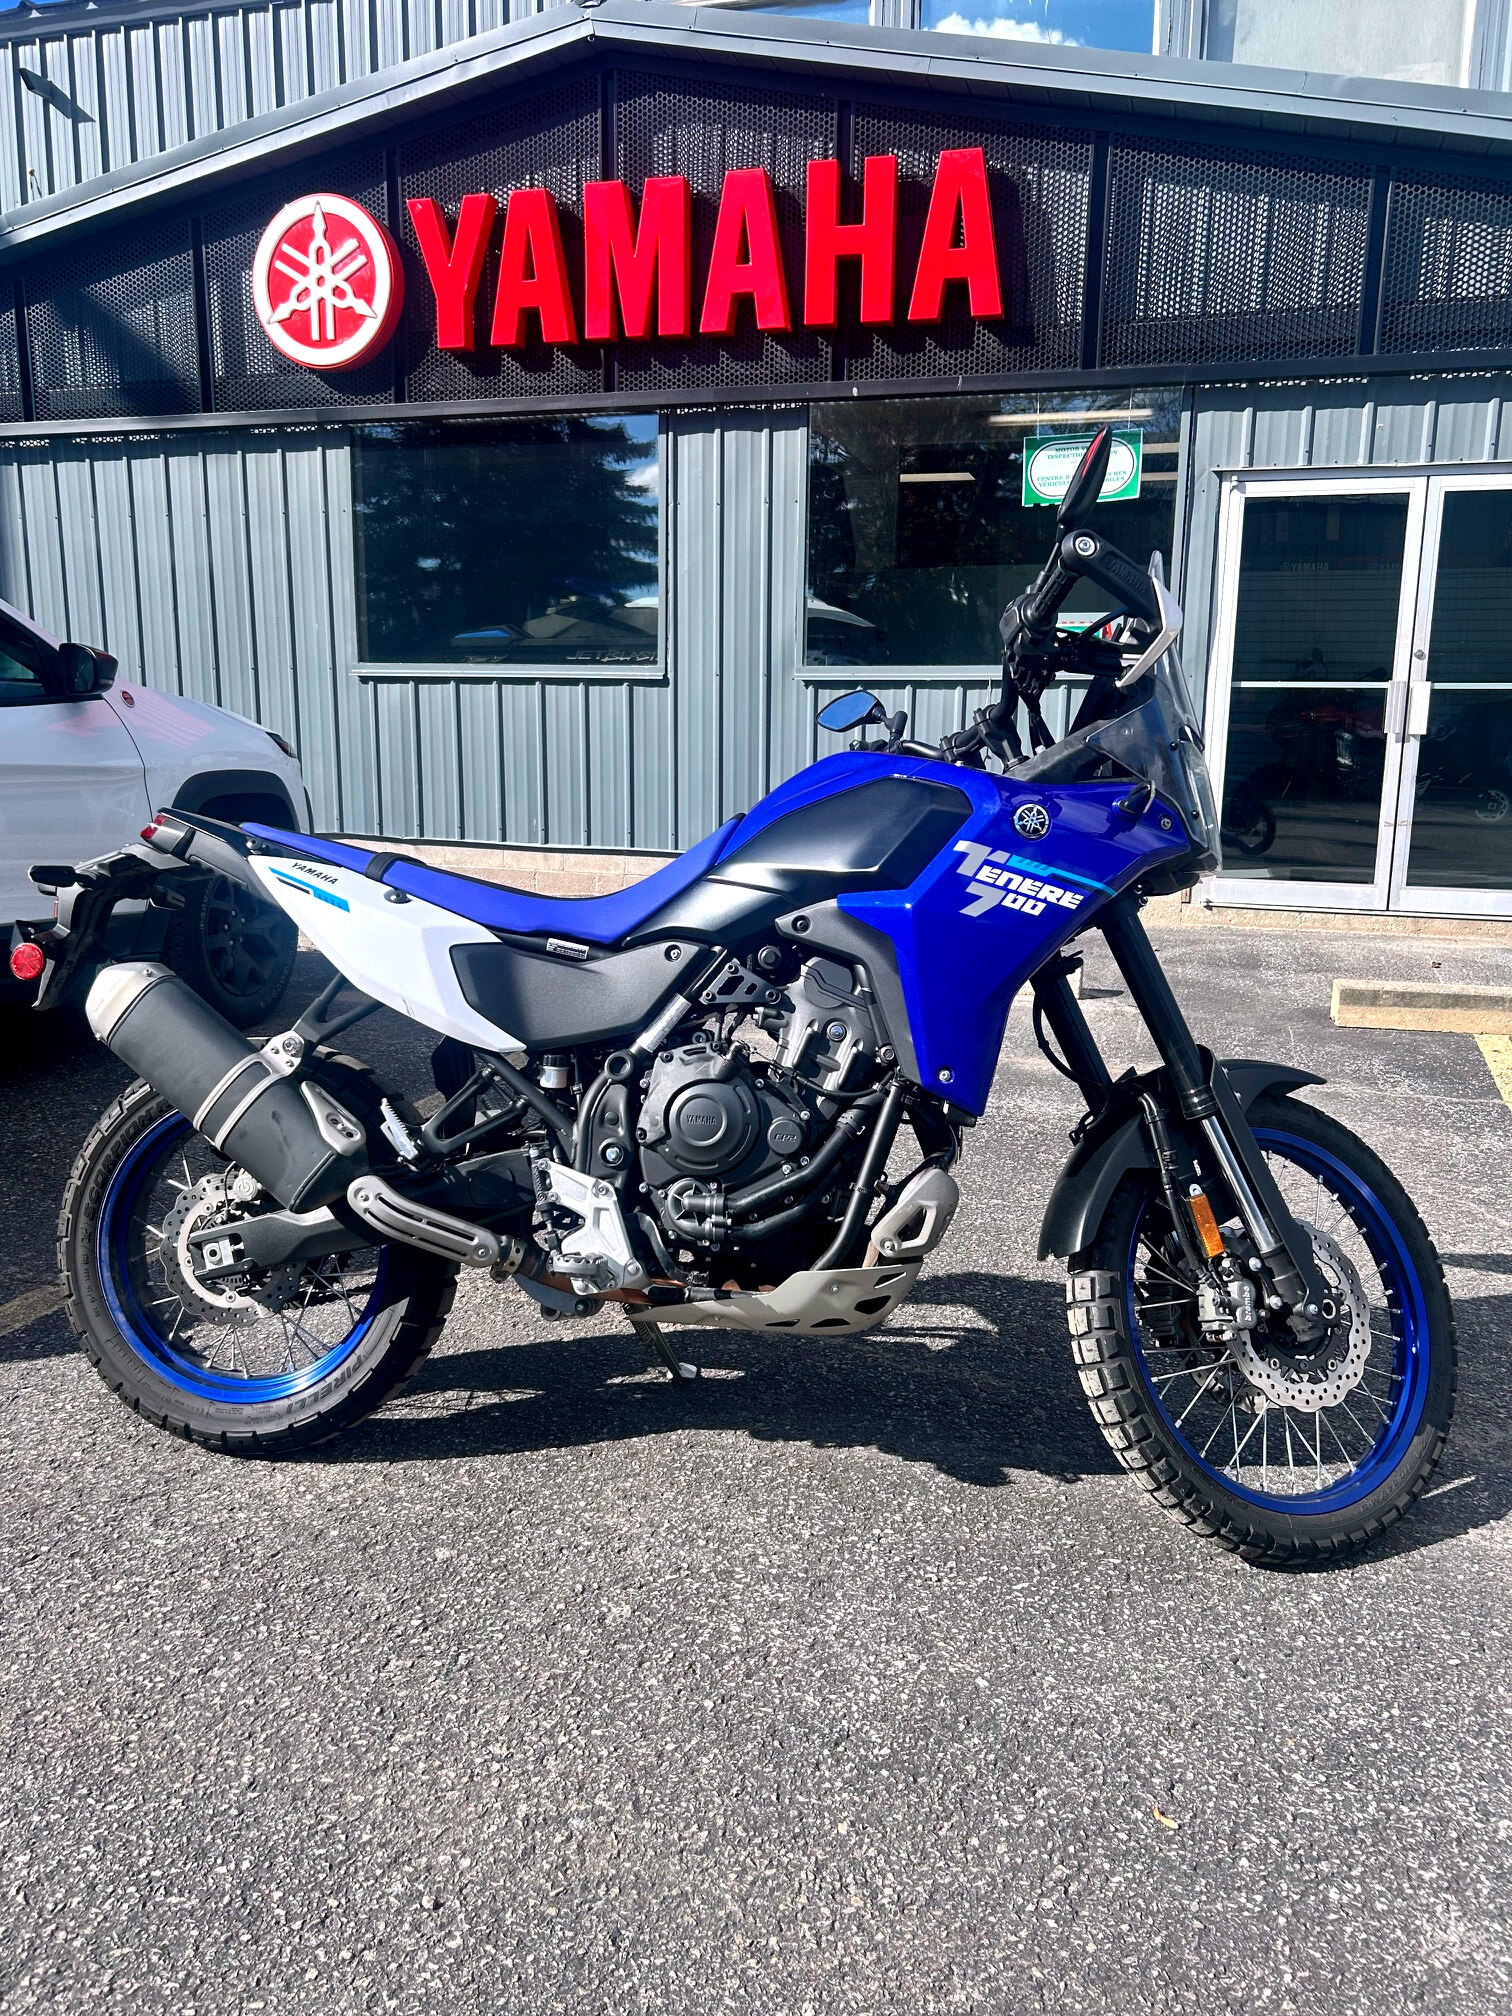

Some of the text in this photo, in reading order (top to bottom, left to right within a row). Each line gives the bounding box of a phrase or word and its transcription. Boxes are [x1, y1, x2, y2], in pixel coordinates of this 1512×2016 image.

[406, 147, 1004, 352] YAMAHA
[1047, 452, 1084, 460] INSPECTIO
[291, 862, 339, 885] YAMAHA
[959, 881, 1047, 918] 700
[686, 1114, 717, 1126] YAMAHA
[1243, 1285, 1252, 1321] brembo
[285, 1355, 364, 1415] PIRELLI
